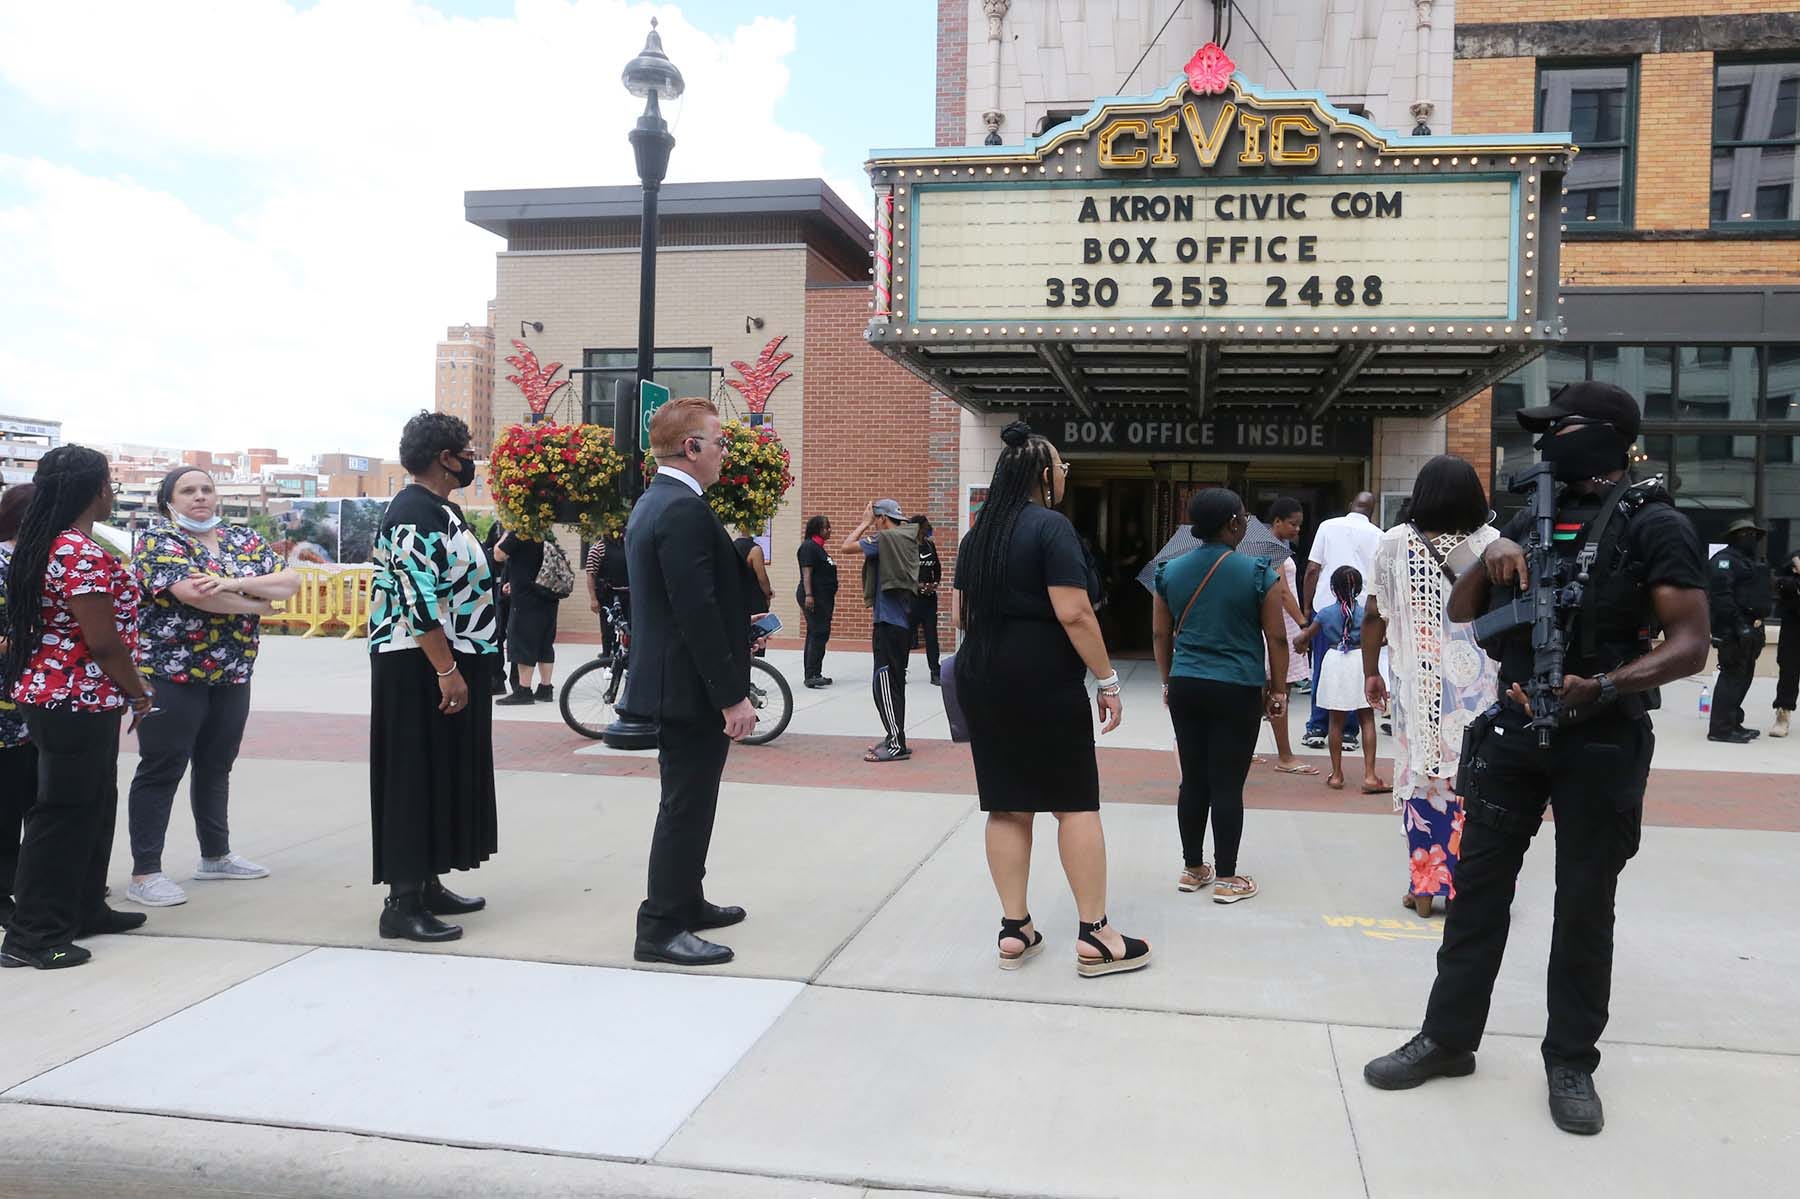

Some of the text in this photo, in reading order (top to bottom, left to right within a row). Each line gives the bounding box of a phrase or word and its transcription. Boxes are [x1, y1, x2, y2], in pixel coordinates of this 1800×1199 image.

[1098, 102, 1320, 169] CIVIC
[1080, 190, 1401, 222] AKRON CIVIC COM
[1084, 235, 1317, 264] BOX OFFICE
[1046, 275, 1382, 307] 330 253 2488
[1064, 421, 1324, 446] BOX OFFICE INSIDE
